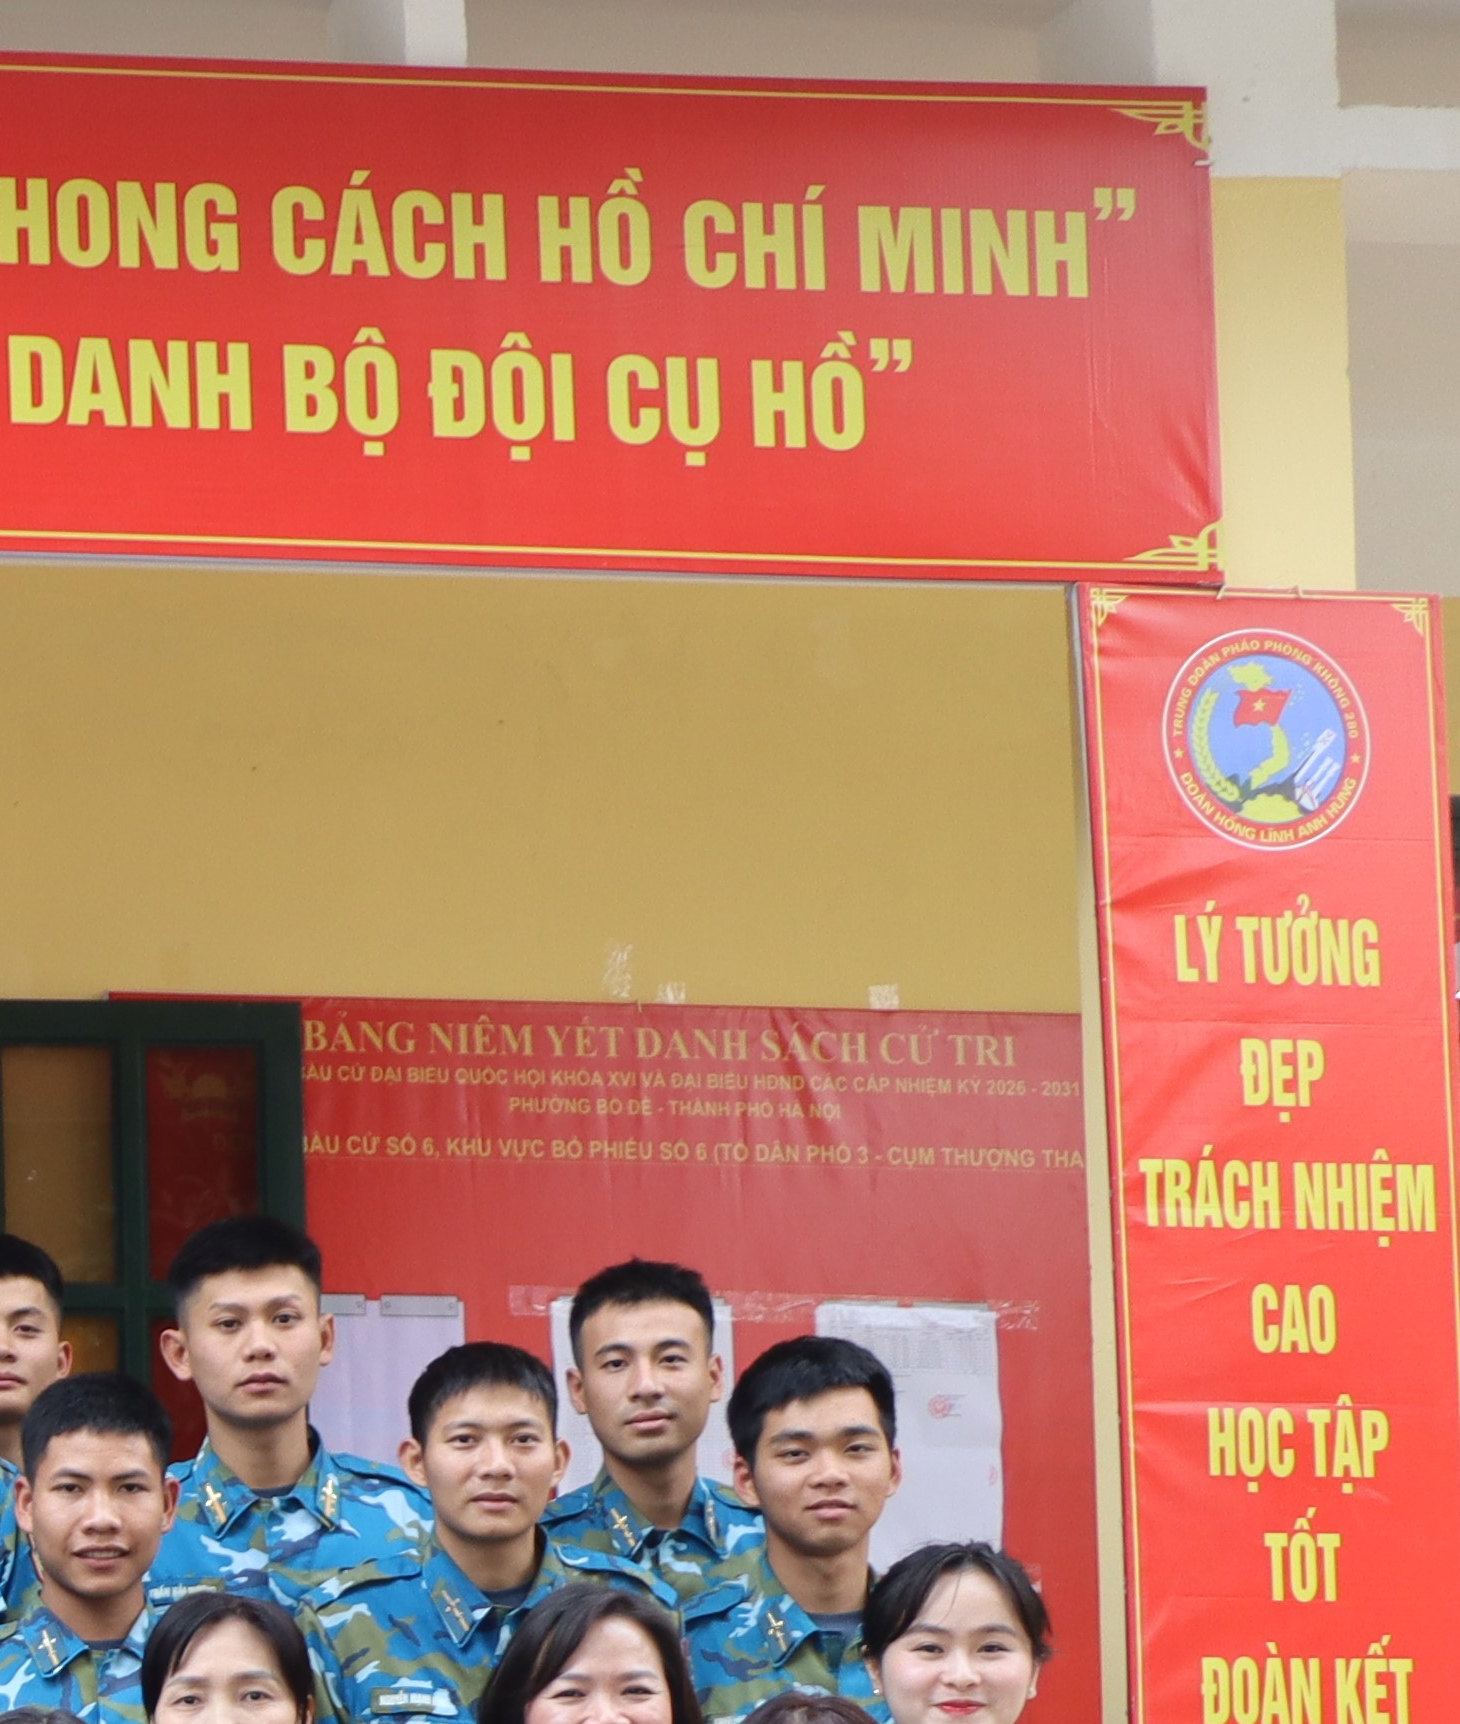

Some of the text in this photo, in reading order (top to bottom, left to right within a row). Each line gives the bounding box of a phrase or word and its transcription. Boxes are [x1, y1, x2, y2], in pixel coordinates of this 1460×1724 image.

[272, 169, 508, 280] CÁCH
[538, 167, 653, 286] HỒ
[684, 184, 827, 291] CHÍ
[858, 186, 1137, 298] MINH”
[8, 334, 254, 430] DANH
[283, 326, 401, 456] BỘ
[428, 331, 577, 461] ĐỘI
[607, 353, 722, 466] CỤ
[751, 329, 914, 451] HỒ”
[1172, 688, 1192, 736] TRUNG
[1298, 815, 1326, 837] ANH
[1174, 893, 1383, 987] LÝ TƯỞNG
[303, 1010, 416, 1052] BẢNG
[429, 1014, 534, 1055] NIÊM
[544, 1016, 624, 1057] YẾT
[636, 1025, 749, 1061] DANH
[761, 1022, 868, 1063] SÁCH
[948, 1034, 1017, 1066] TRI
[1240, 1037, 1327, 1123] ĐẸP
[422, 1138, 439, 1158] 6,
[447, 1138, 492, 1157] KHU
[696, 1146, 707, 1161] 6
[756, 1140, 799, 1163] DÂN
[858, 1147, 868, 1164] 3
[888, 1147, 935, 1169] CỤM
[1138, 1144, 1439, 1248] TRÁCH NHIỆM
[1252, 1283, 1338, 1355] CAO
[1208, 1393, 1391, 1494] HỌC TẬP
[1264, 1507, 1343, 1603] TỐT
